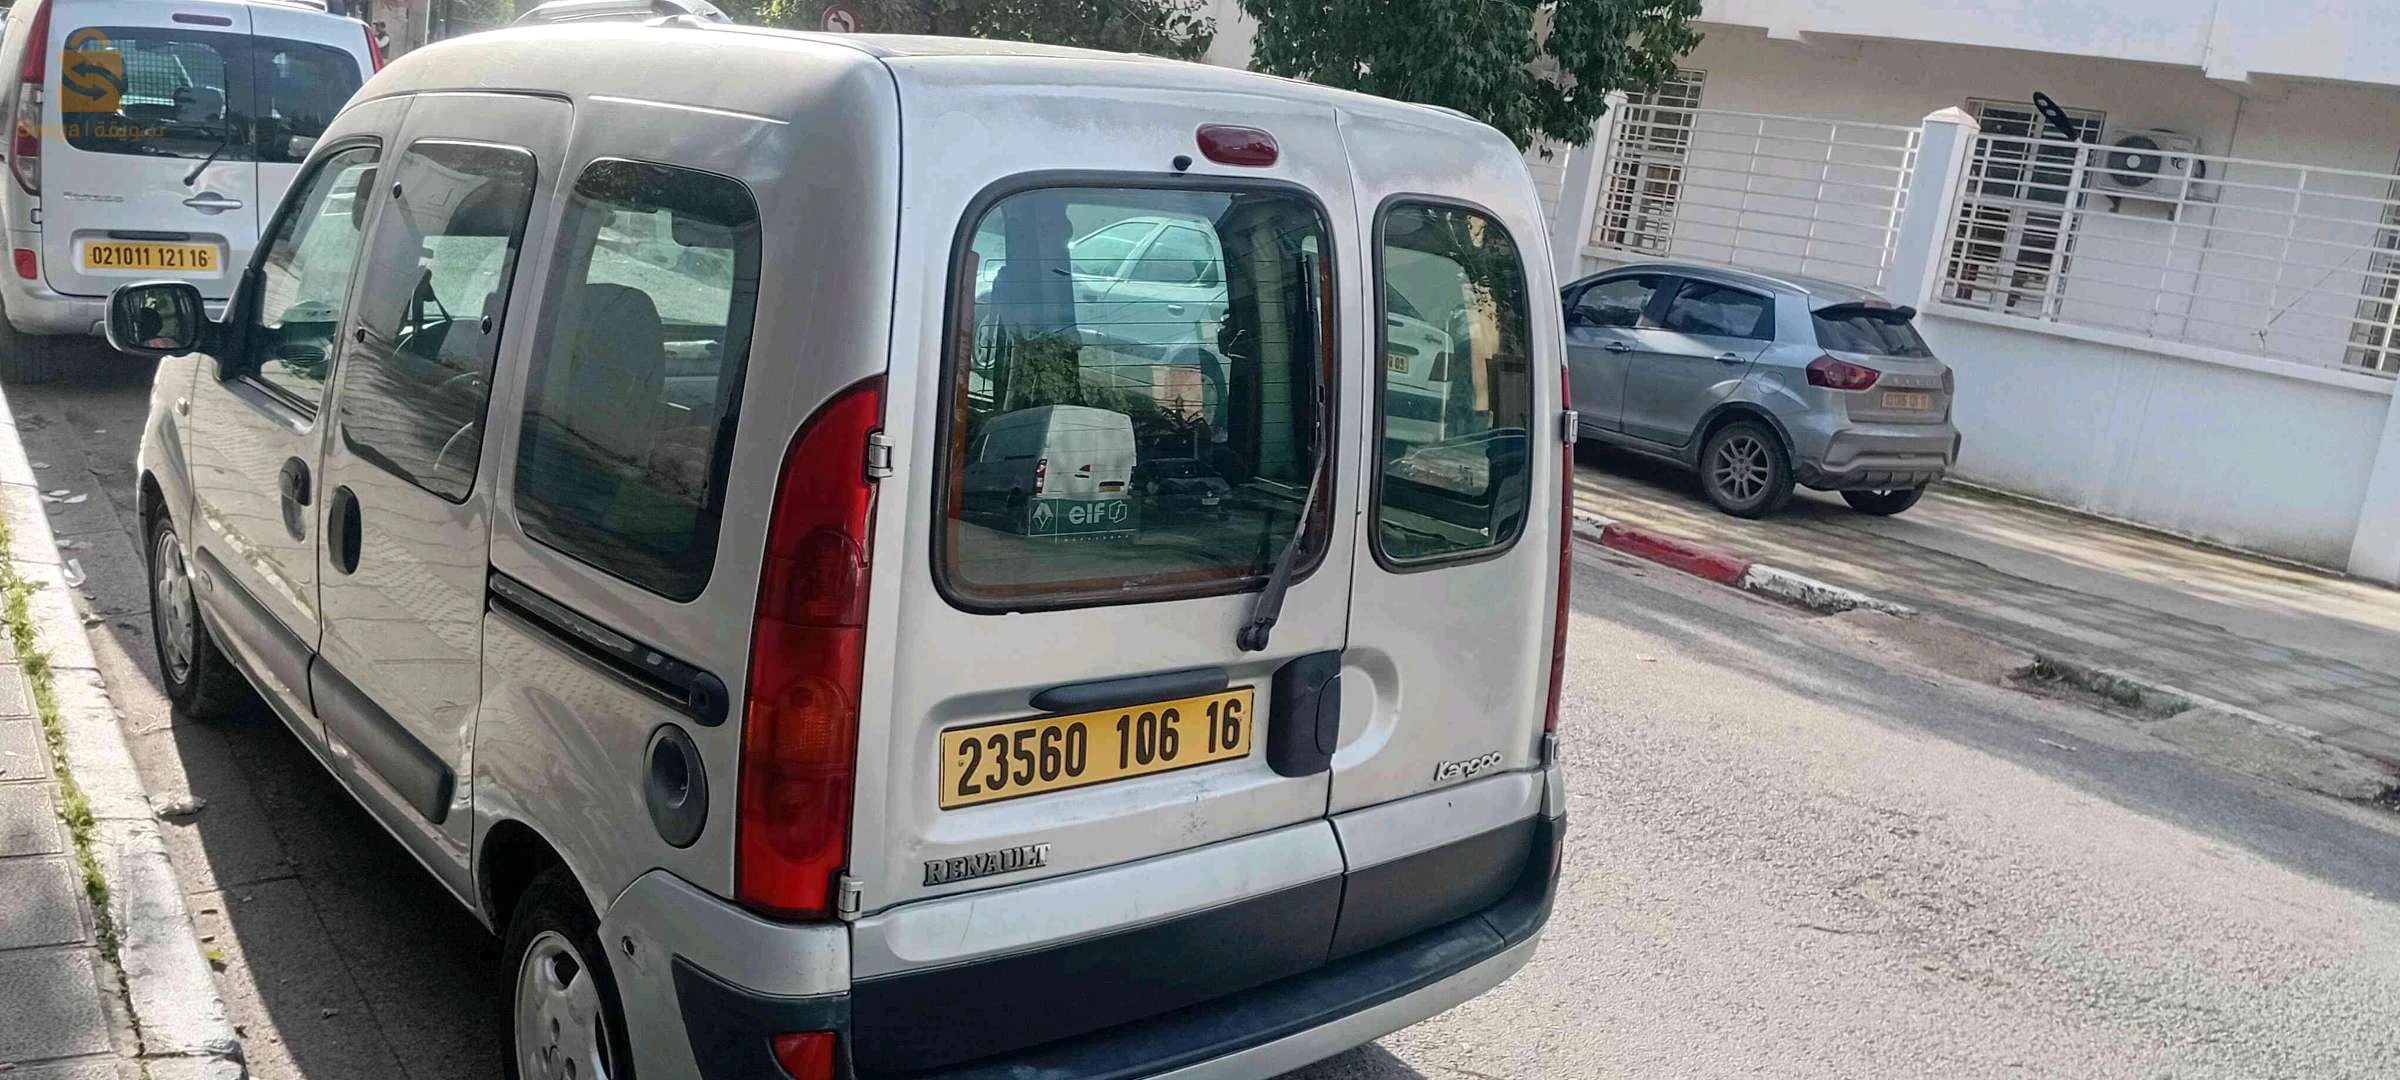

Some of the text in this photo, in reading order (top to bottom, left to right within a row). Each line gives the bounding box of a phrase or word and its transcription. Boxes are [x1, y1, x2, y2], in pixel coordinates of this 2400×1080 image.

[93, 247, 207, 267] 021011 121 16
[1069, 503, 1105, 524] elf
[958, 698, 1242, 796] 23560 106 16
[1433, 751, 1502, 780] Kangoo
[923, 843, 1050, 887] RENAULT
